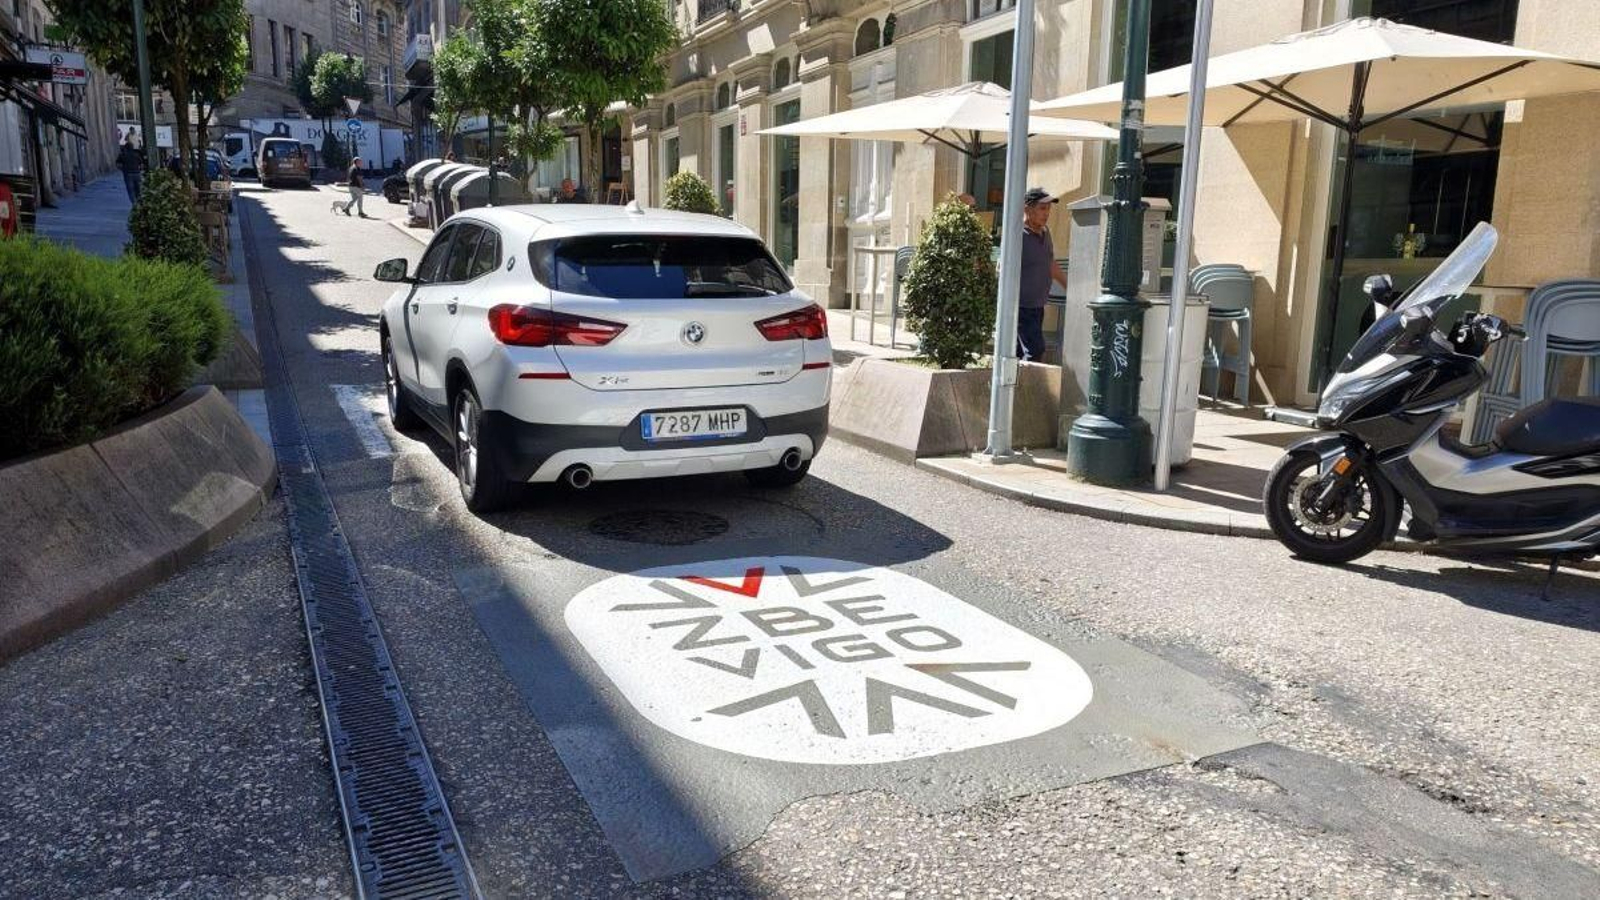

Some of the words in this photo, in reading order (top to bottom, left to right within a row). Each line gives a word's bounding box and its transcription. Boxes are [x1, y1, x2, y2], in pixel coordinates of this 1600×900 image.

[655, 414, 702, 435] 7287
[708, 412, 741, 431] MHP
[685, 625, 963, 680] VIGO
